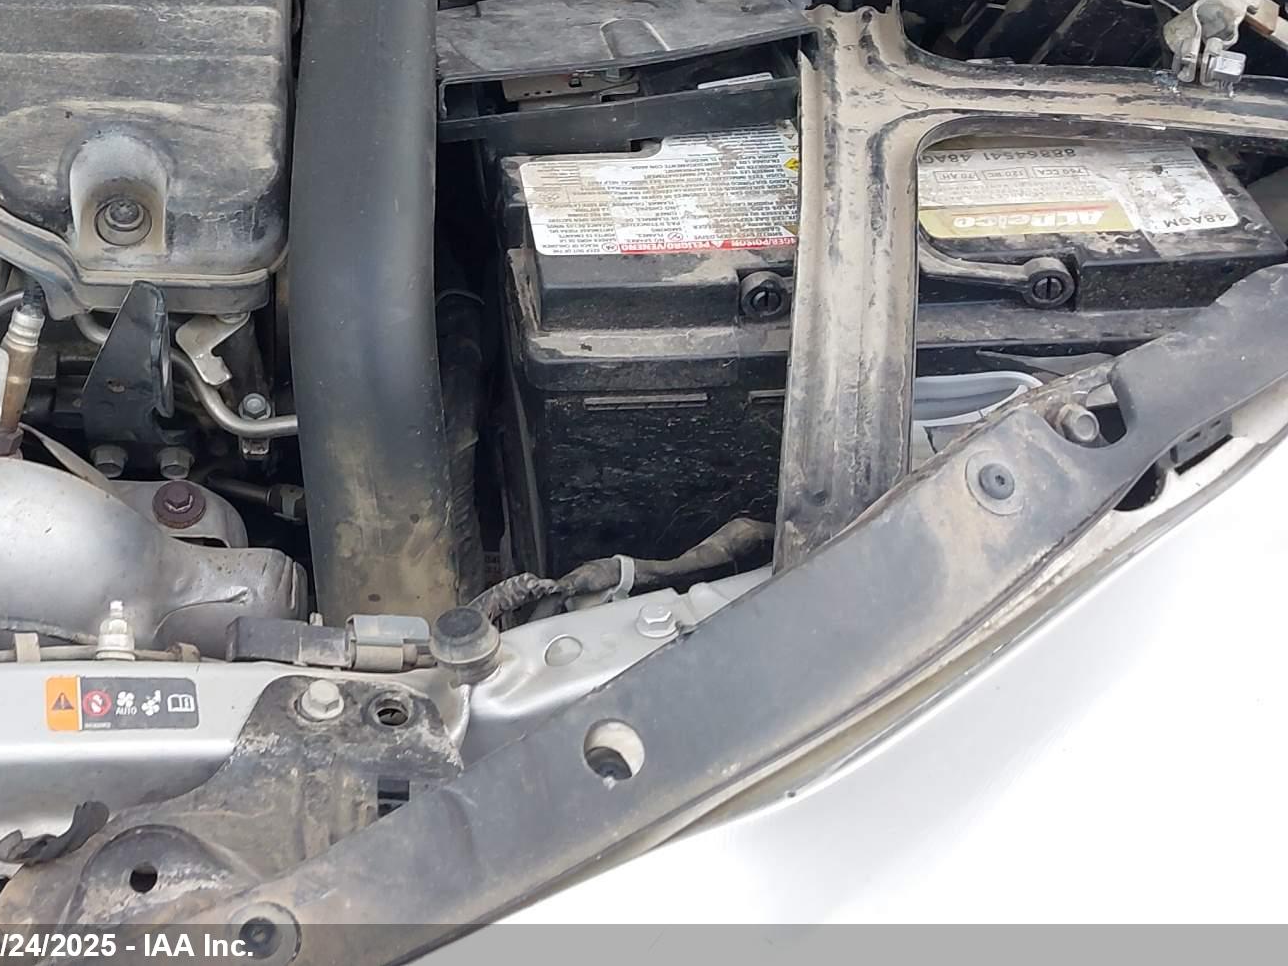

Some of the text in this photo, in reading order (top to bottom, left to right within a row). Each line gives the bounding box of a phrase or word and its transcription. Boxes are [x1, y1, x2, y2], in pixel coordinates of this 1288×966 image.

[917, 152, 972, 165] 48AG
[1163, 214, 1227, 228] 48AGM
[115, 706, 138, 715] AUTO
